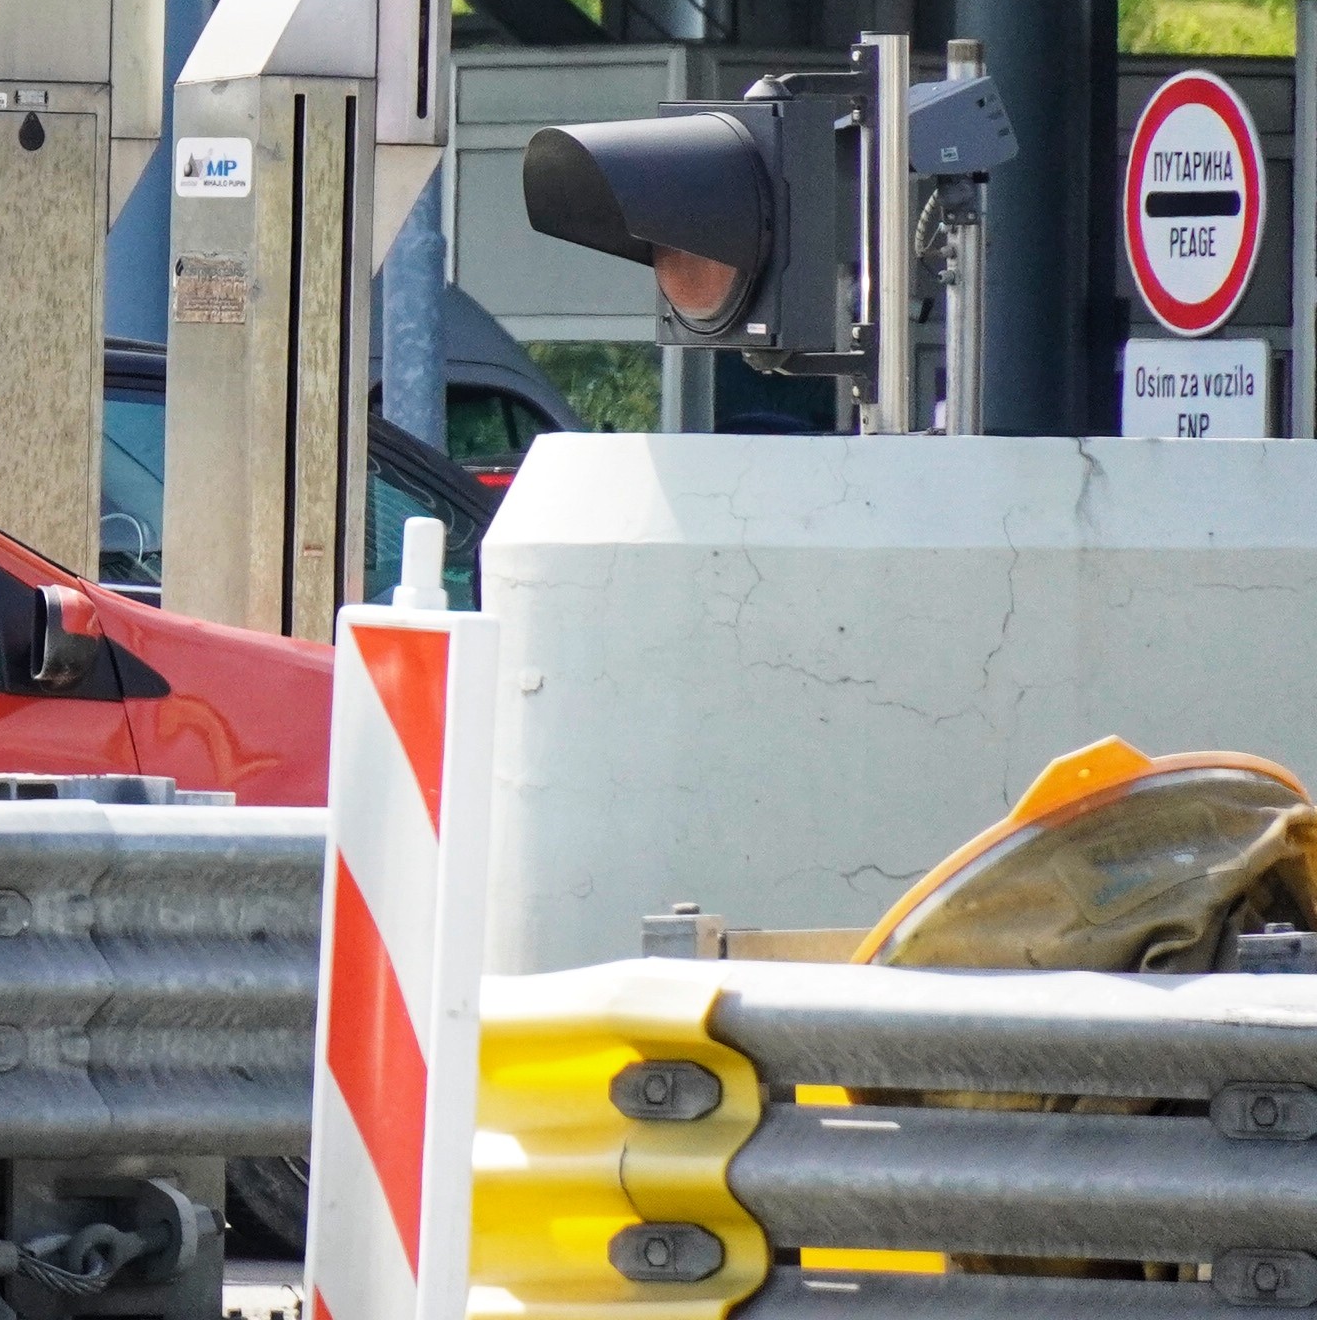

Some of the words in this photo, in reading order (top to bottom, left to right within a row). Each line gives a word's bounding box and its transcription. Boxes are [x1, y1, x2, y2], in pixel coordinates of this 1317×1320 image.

[1153, 151, 1233, 182] ПУТАРИНА
[1169, 227, 1217, 258] PEAGE
[1135, 365, 1176, 398] Osim
[1180, 373, 1199, 398] za
[1204, 364, 1254, 397] vozila
